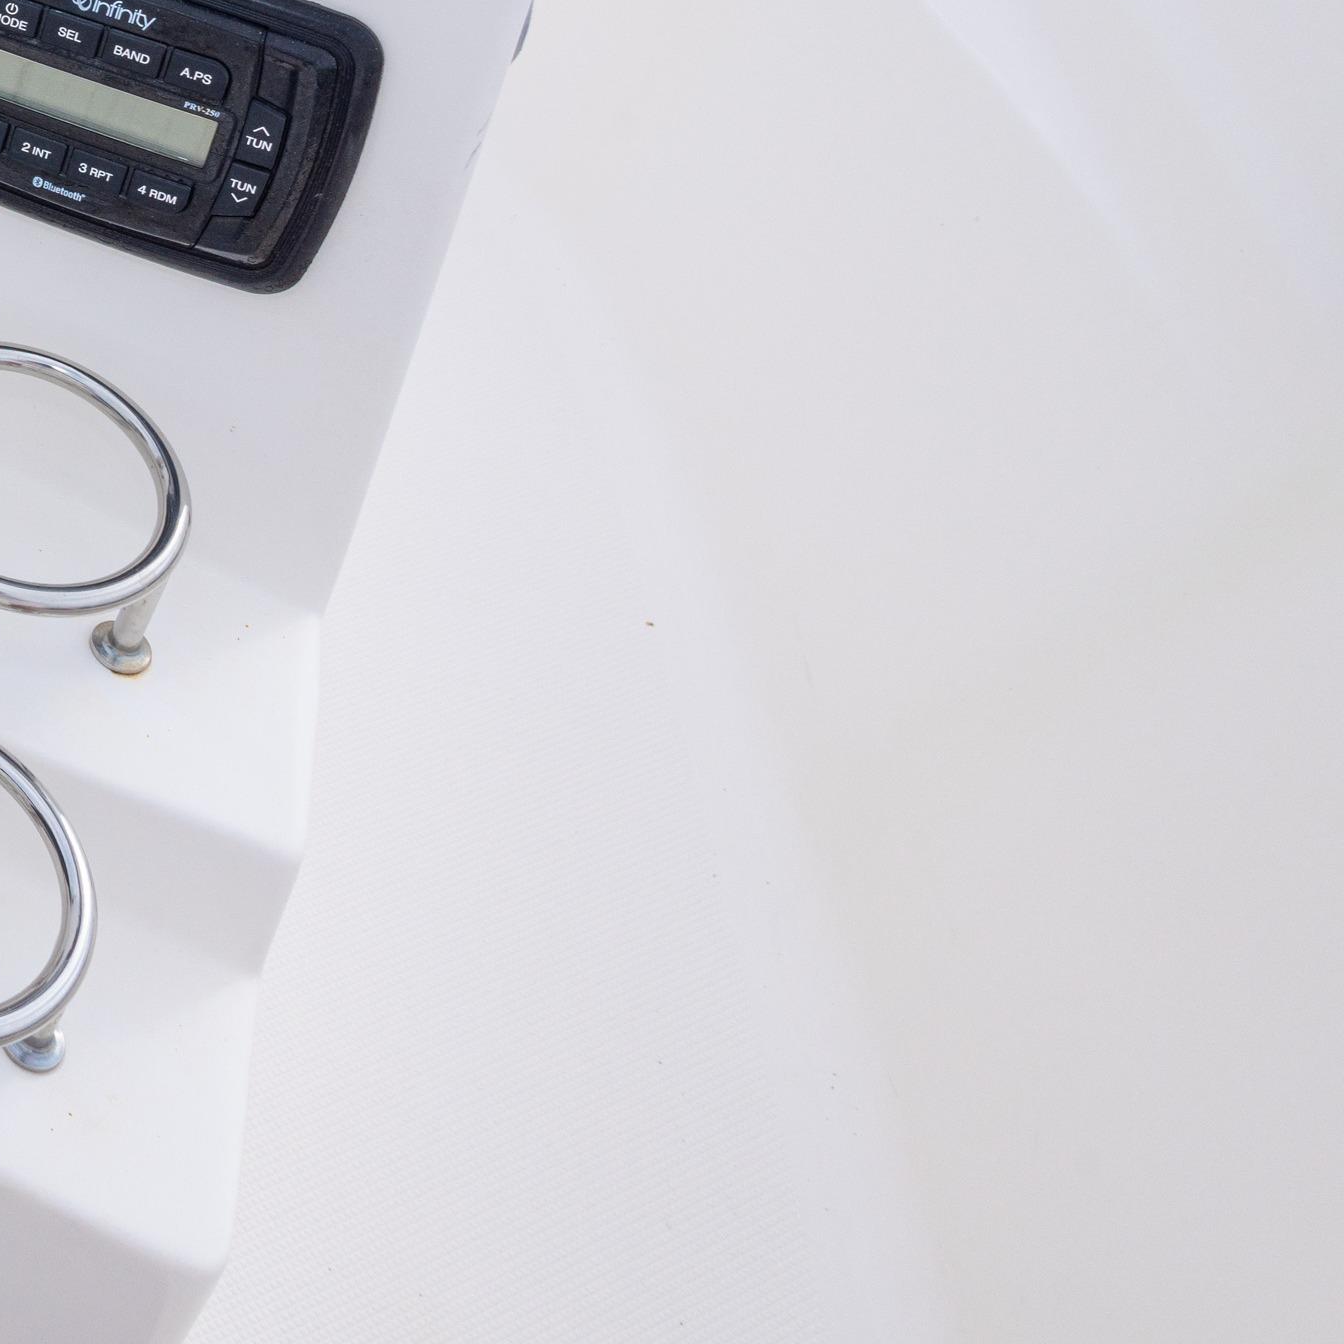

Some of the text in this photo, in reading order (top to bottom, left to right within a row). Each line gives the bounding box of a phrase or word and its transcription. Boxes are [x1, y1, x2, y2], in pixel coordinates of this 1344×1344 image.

[58, 27, 81, 43] SEL
[113, 45, 150, 65] BAND
[180, 68, 212, 85] A.PS
[21, 143, 51, 159] 2 INT
[246, 136, 273, 152] TUN
[78, 163, 113, 182] 3 RPT
[230, 178, 257, 194] TUN
[138, 185, 177, 205] 4 RDM
